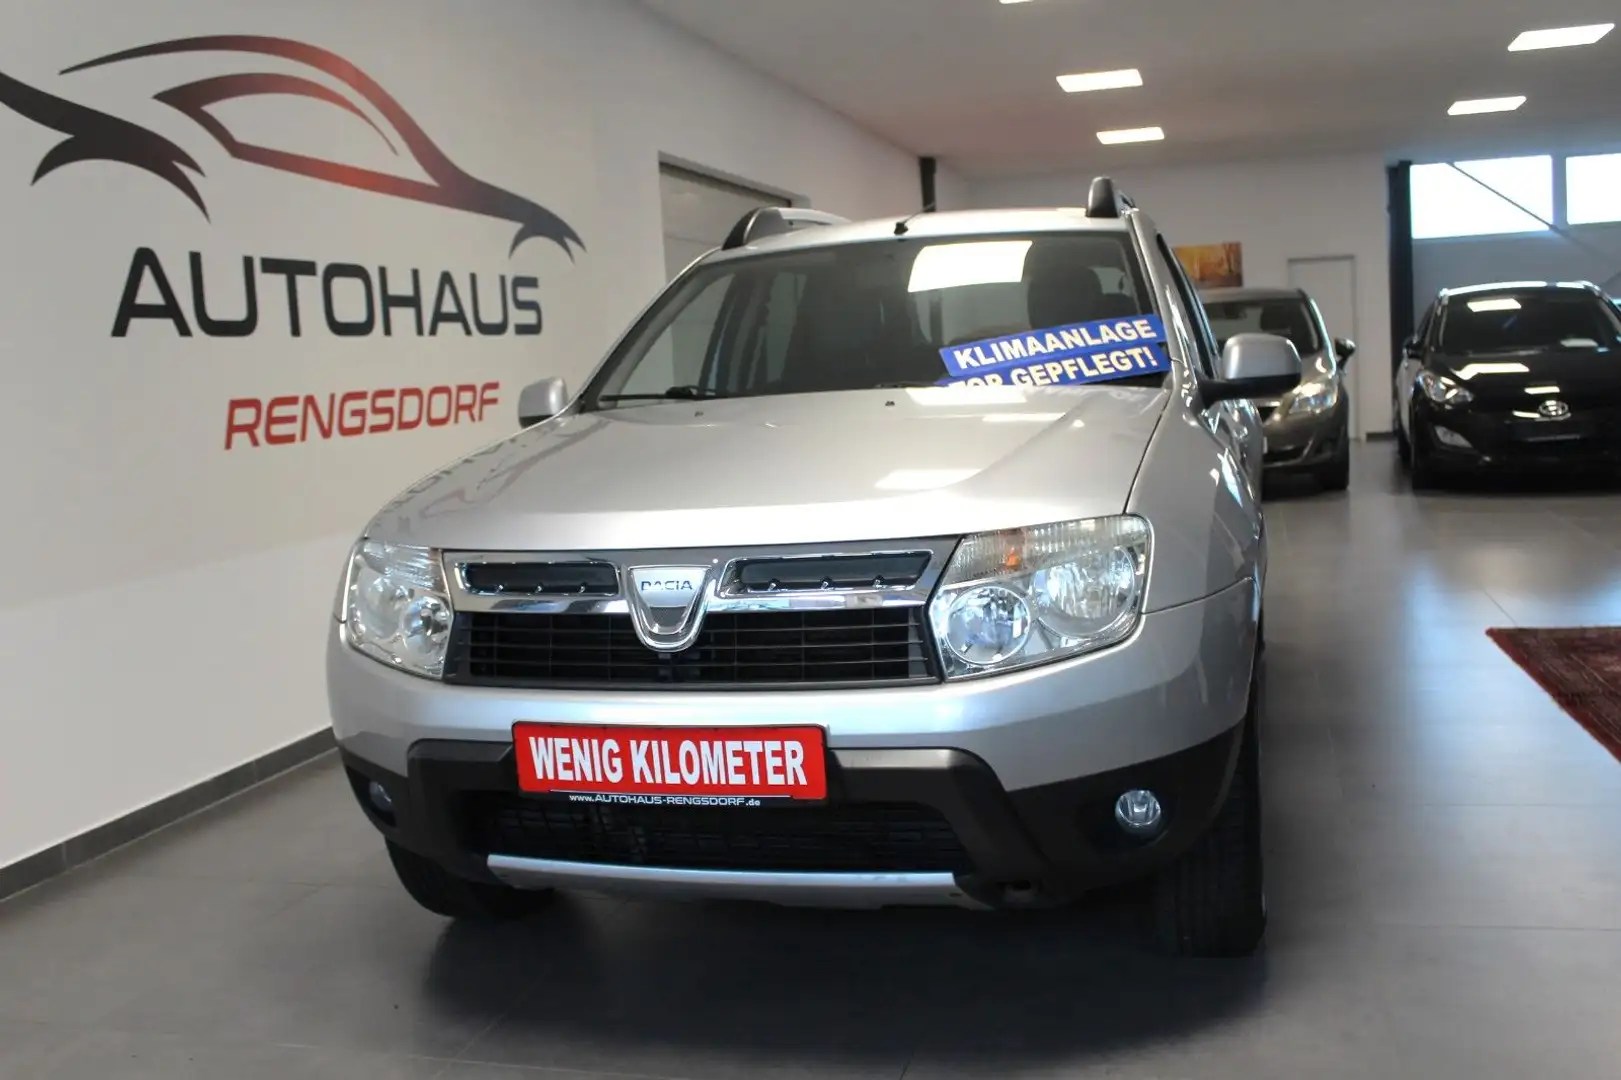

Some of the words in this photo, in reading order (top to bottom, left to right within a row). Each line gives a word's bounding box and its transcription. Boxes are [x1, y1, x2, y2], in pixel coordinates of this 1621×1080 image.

[111, 246, 544, 338] AUTOHAUS
[953, 318, 1157, 370] KLIMAANLAGE
[1011, 346, 1158, 387] GEPFLEGT!
[224, 381, 500, 450] RENGSDORF
[641, 580, 693, 591] DACIA
[528, 736, 624, 784] WENIG
[630, 739, 808, 786] KILOMETER
[569, 794, 761, 807] www.AUTOHAUS-RENGSDORF.de
